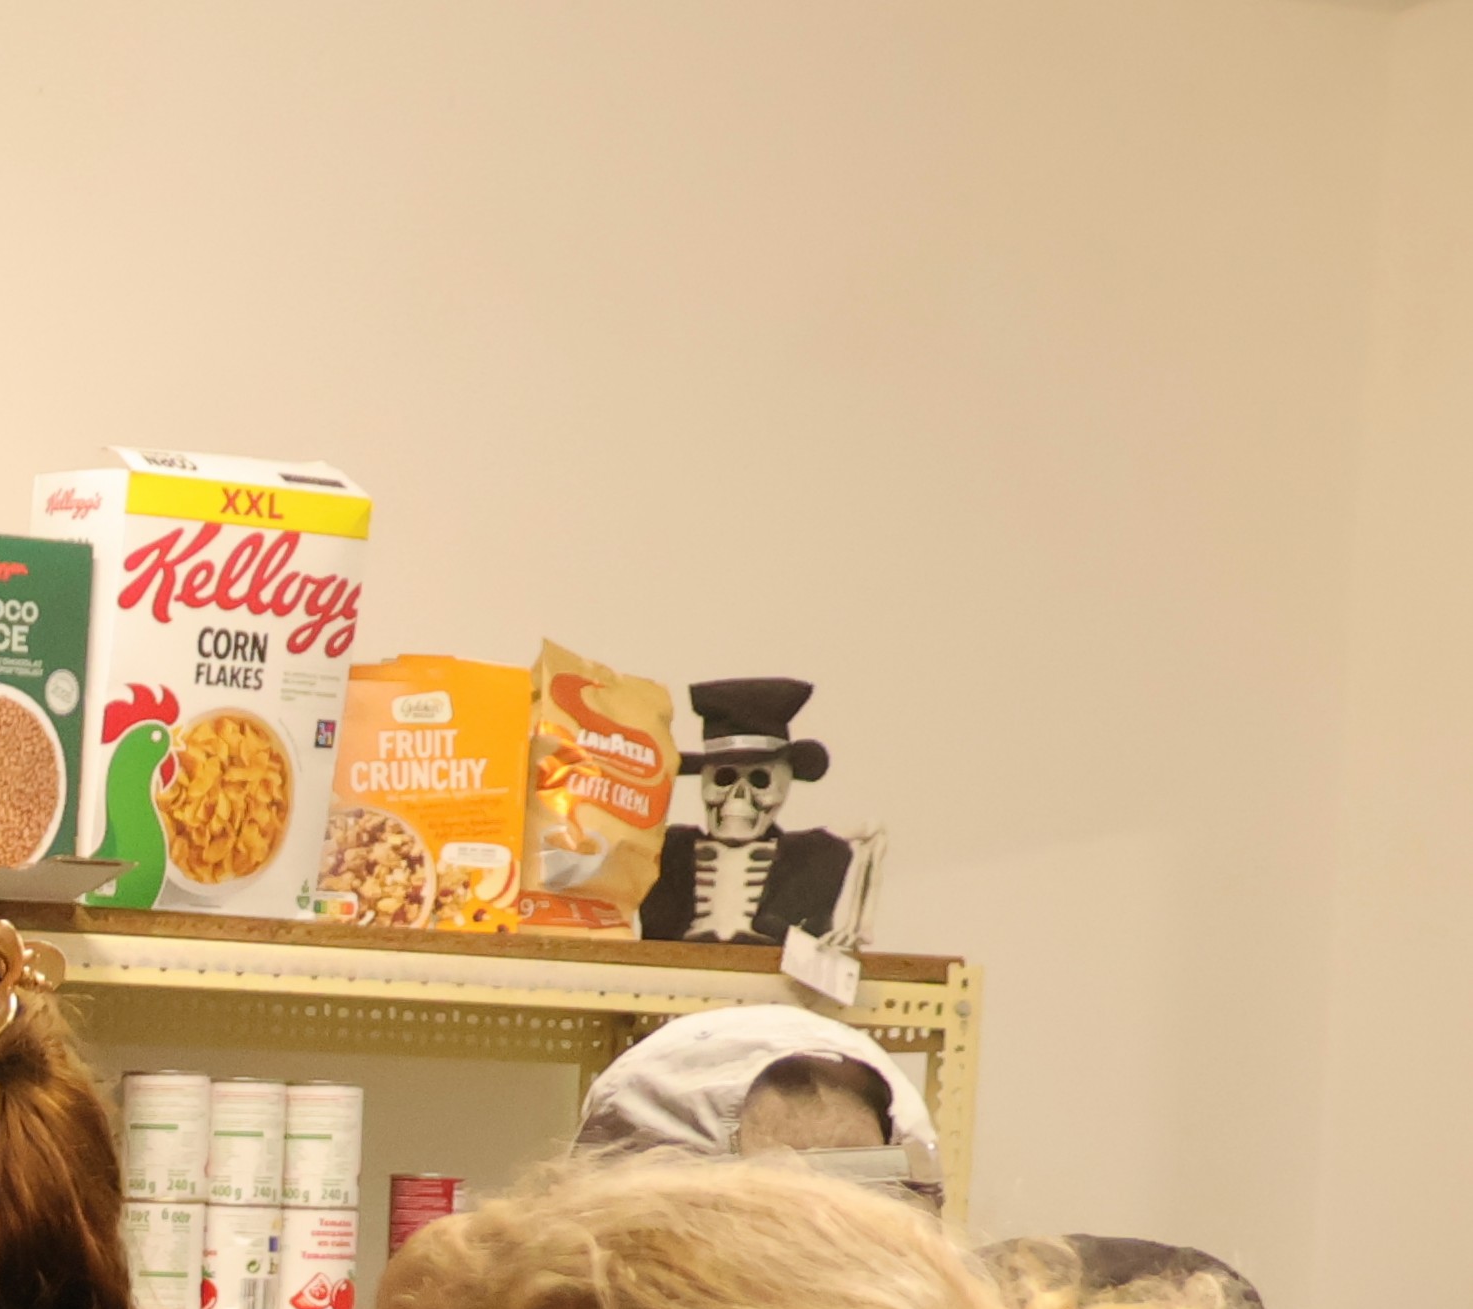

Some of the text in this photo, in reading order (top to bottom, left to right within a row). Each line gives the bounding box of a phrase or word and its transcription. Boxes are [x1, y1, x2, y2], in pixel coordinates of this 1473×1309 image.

[220, 488, 284, 520] XXL
[197, 626, 269, 664] CORN
[195, 662, 263, 692] FLAKES
[378, 729, 459, 759] FRUIT
[576, 729, 656, 767] LAVAZZA
[350, 758, 488, 793] CRUNCHY
[612, 783, 650, 817] CREMA
[167, 1178, 188, 1191] 240
[211, 1184, 232, 1198] 400
[253, 1185, 272, 1198] 240
[322, 1186, 341, 1200] 240
